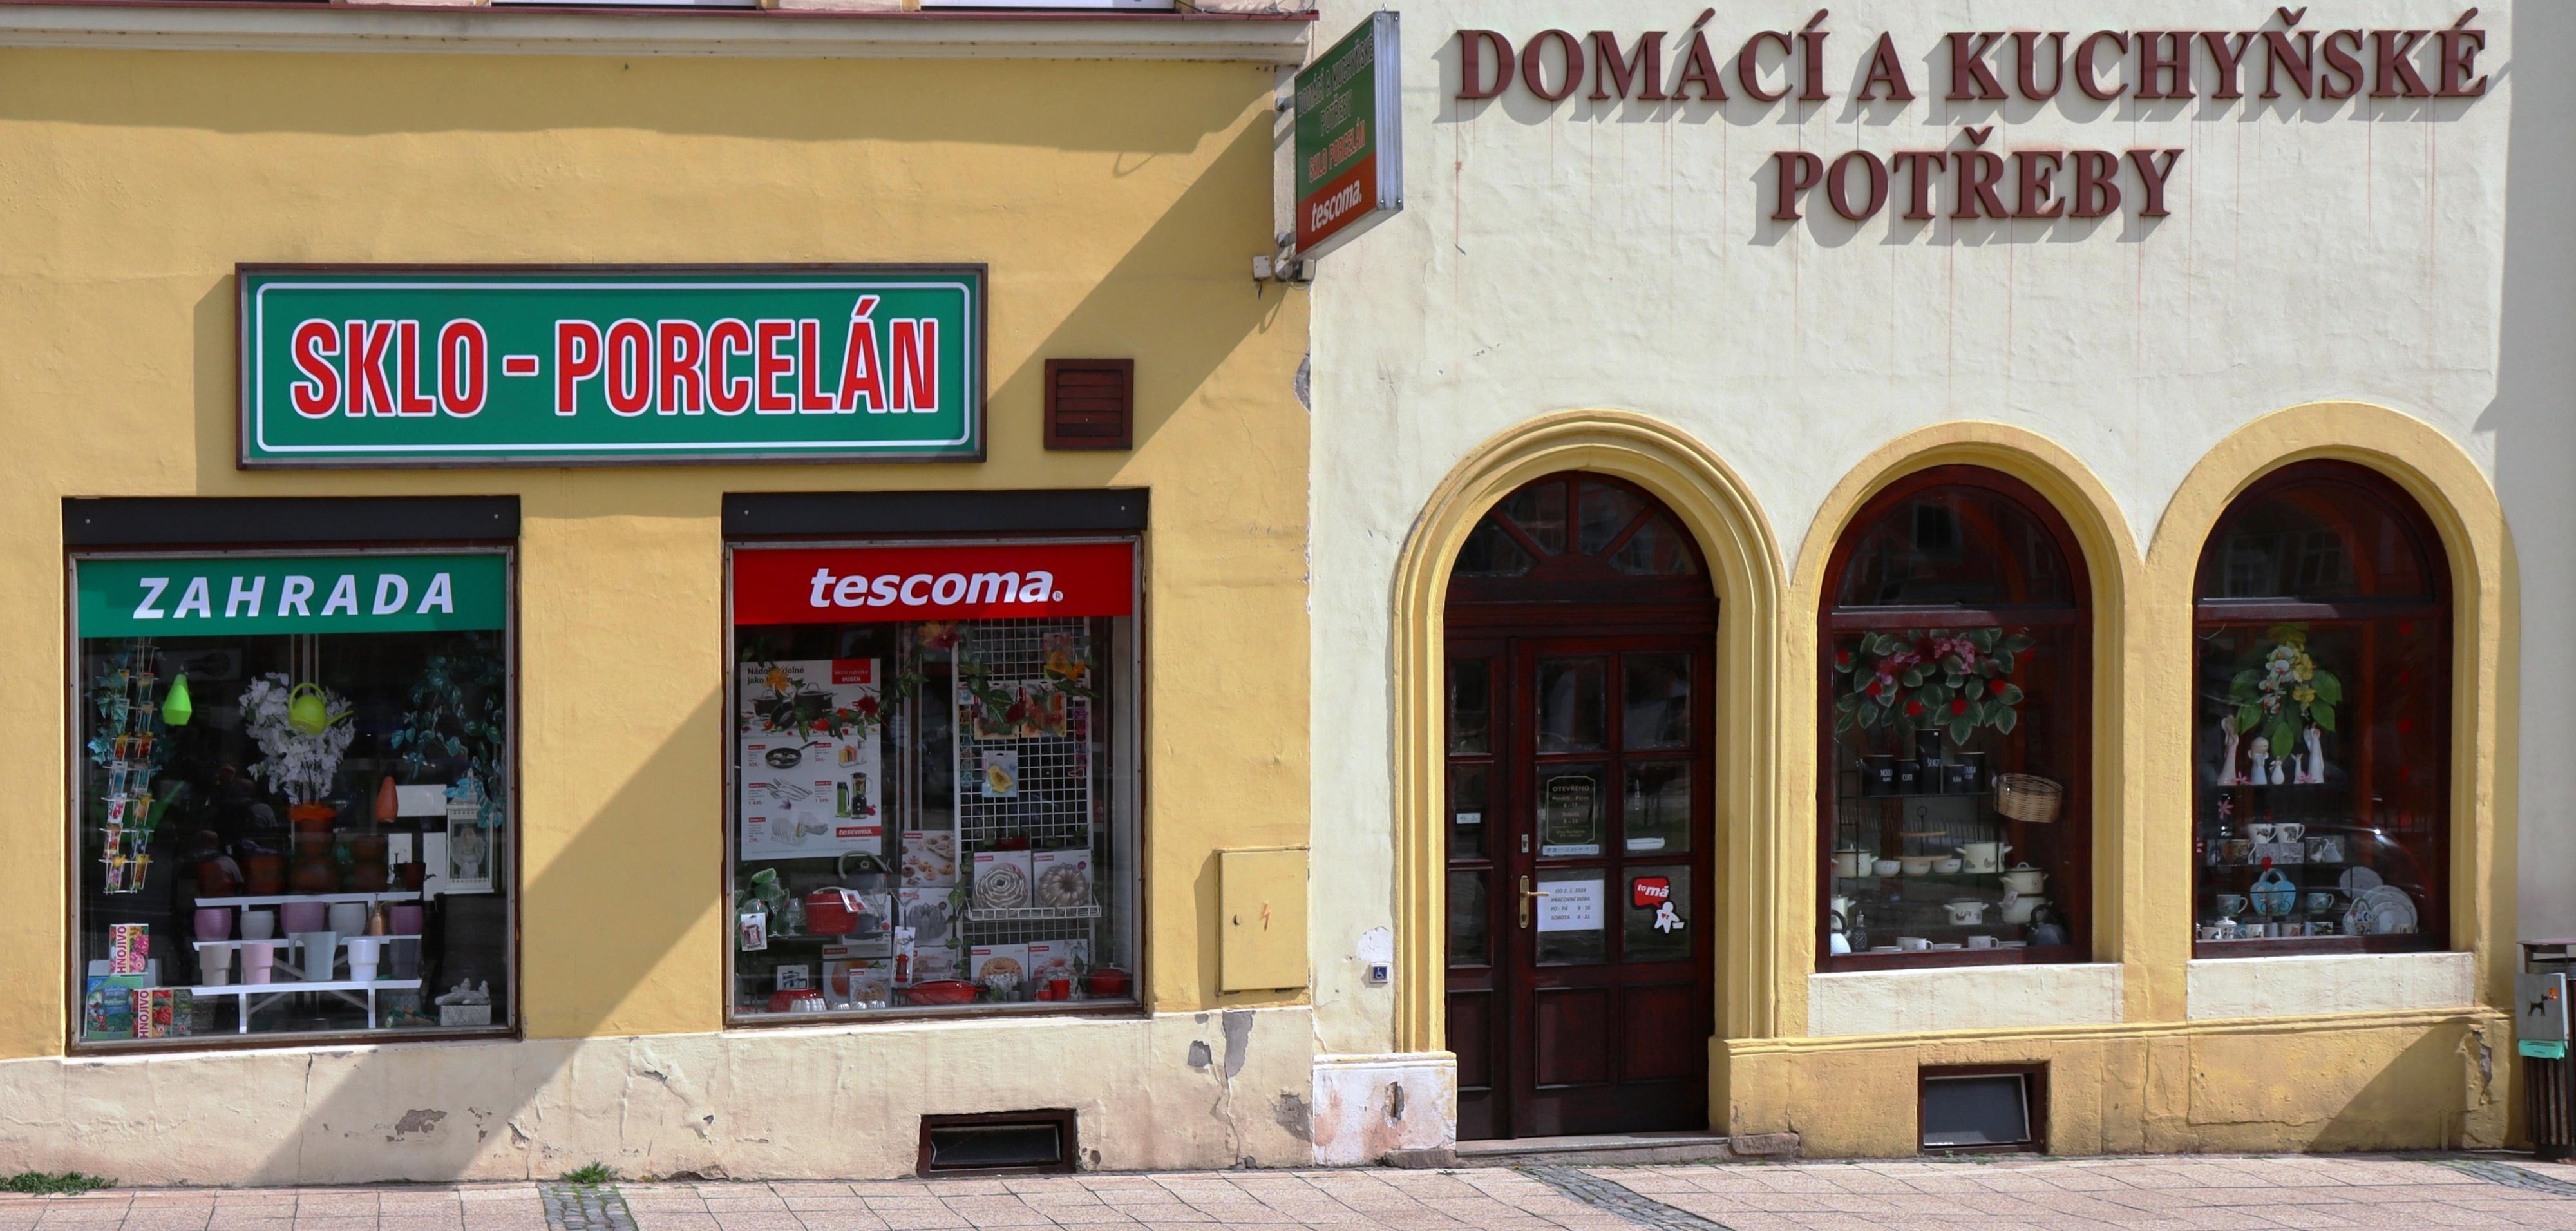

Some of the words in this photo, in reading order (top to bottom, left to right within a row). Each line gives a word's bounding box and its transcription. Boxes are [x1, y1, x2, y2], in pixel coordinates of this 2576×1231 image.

[1297, 67, 1325, 118] DOMÁCÍ
[1326, 75, 1332, 96] A
[1332, 26, 1374, 90] KUCHYŇSKÉ
[1456, 8, 1830, 101] DOMÁCÍ
[1857, 30, 1915, 100] A
[1946, 6, 2488, 101] KUCHYŇSKÉ
[1320, 89, 1352, 138] POTŘEBY
[1309, 146, 1327, 184] SKLO
[1329, 117, 1366, 171] PORCELÁN
[1772, 126, 2185, 220] POTŘEBY
[290, 318, 488, 418] SKLO
[554, 294, 938, 417] PORCELÁN
[133, 573, 454, 619] ZAHRADA
[747, 676, 764, 685] jako
[117, 926, 127, 973] HNOJIVO
[139, 990, 149, 1038] HNOJIVO
